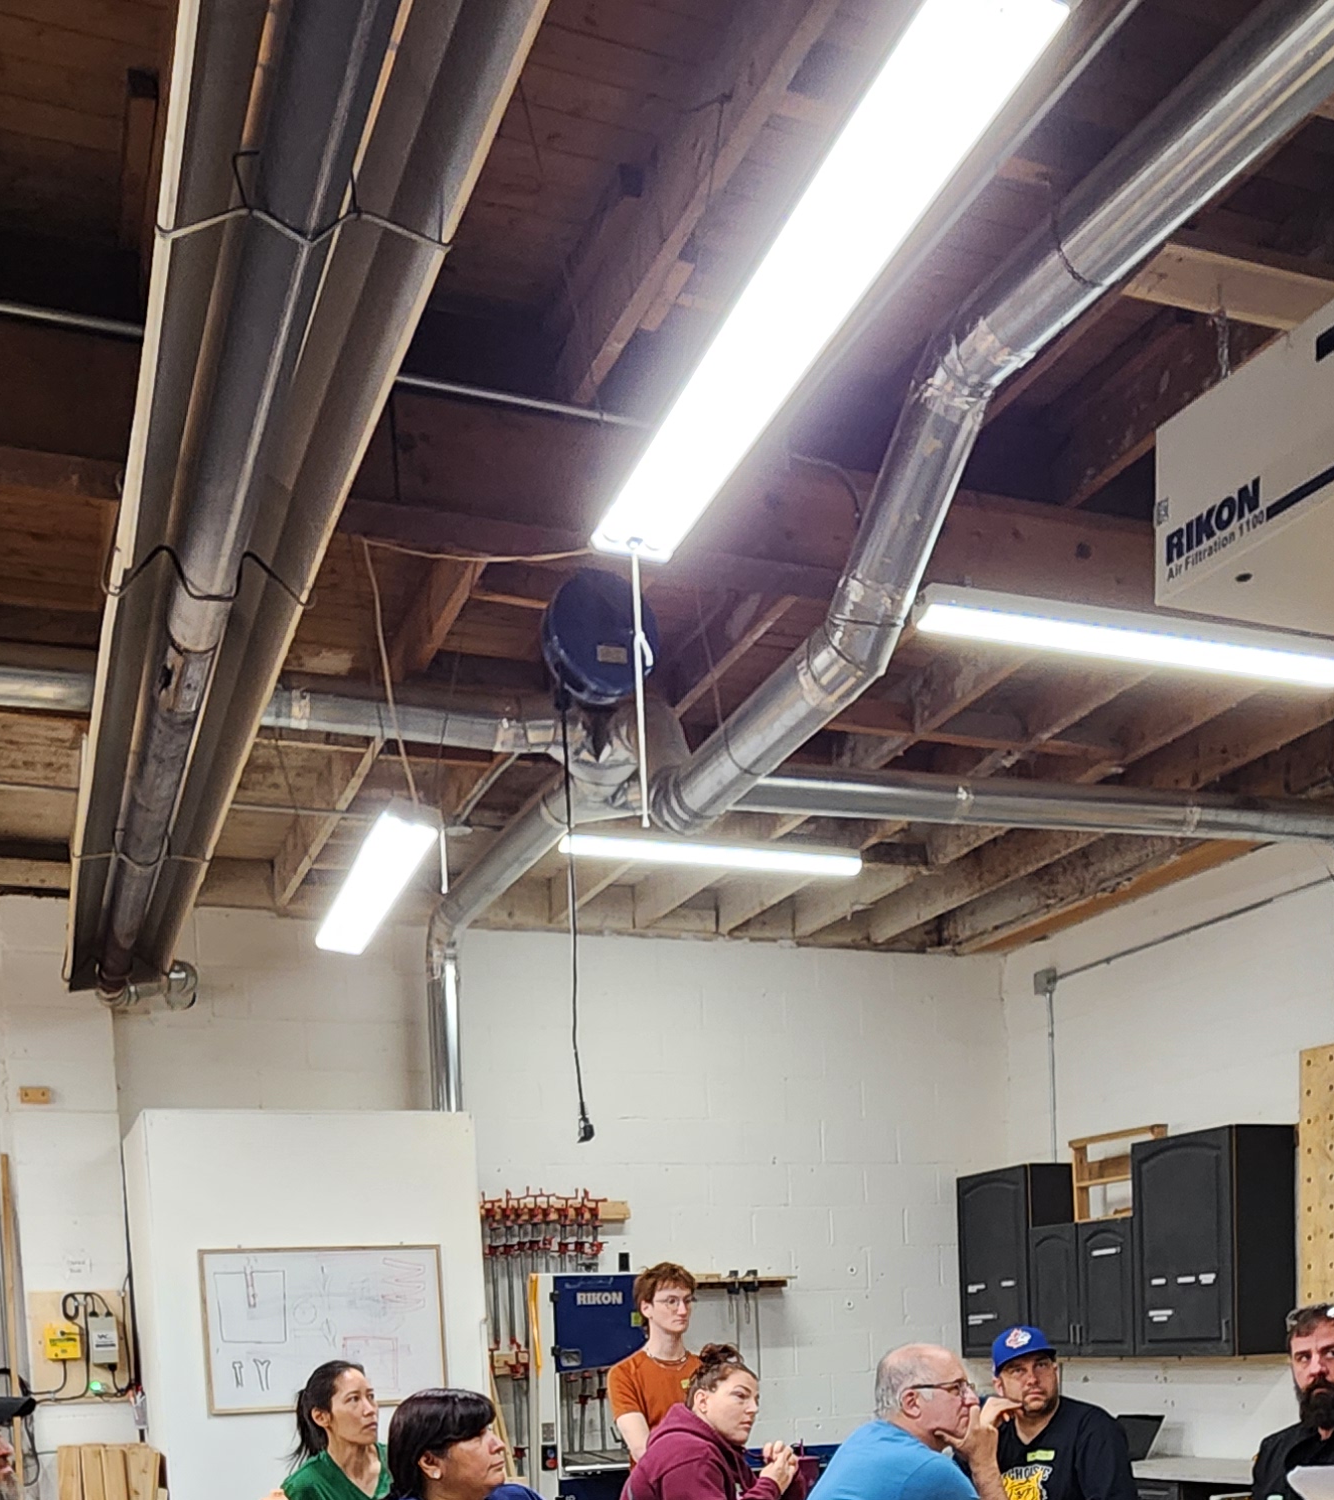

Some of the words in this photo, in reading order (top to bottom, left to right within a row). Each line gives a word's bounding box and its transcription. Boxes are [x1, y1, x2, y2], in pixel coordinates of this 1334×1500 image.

[1166, 475, 1261, 567] RIKON
[1167, 561, 1183, 582] Air
[1184, 533, 1236, 572] Filtration
[1238, 508, 1265, 538] 1100
[576, 1291, 624, 1306] RIKON
